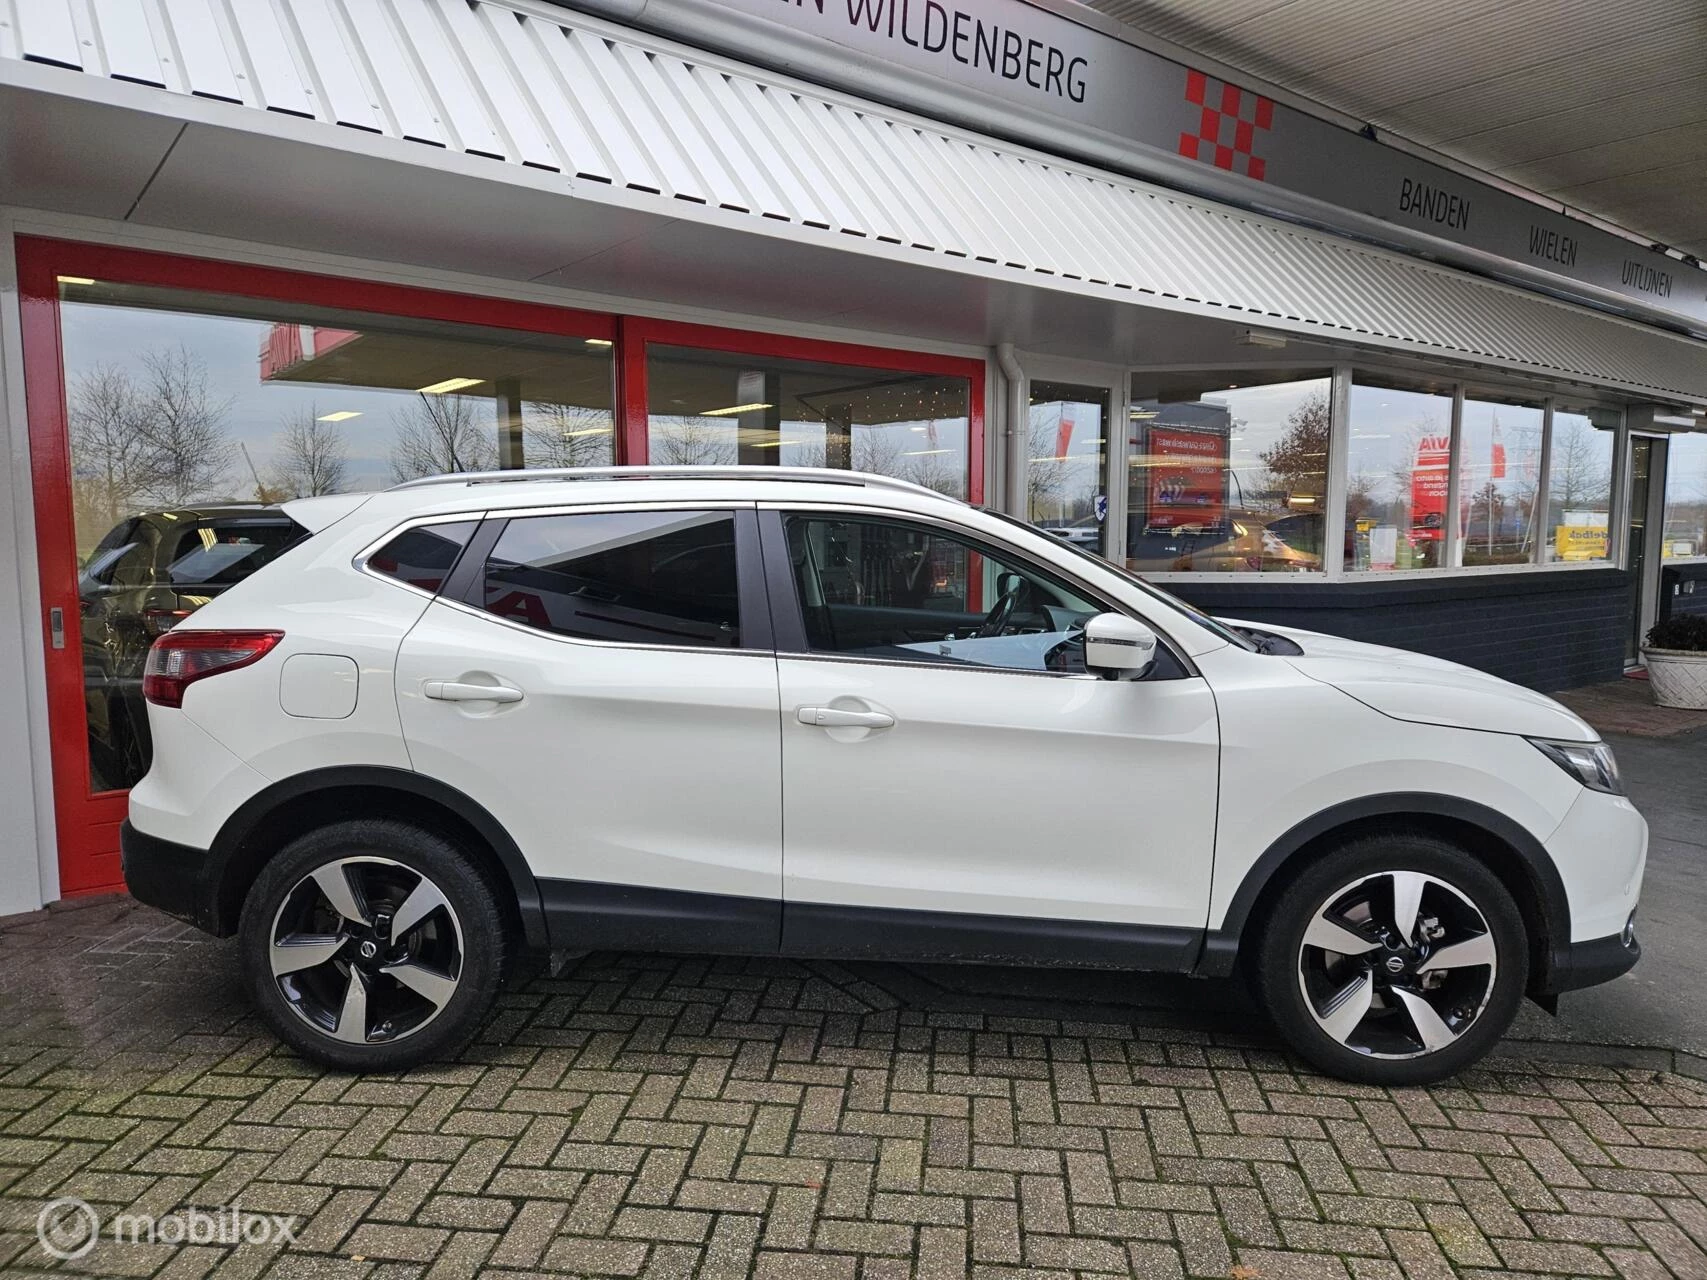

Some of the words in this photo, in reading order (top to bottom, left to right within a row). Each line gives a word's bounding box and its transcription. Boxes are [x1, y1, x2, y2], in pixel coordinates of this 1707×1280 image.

[847, 0, 1088, 103] WILDENBERG
[1399, 178, 1470, 231] BANDEN
[1529, 225, 1578, 268] WIELEN
[1622, 259, 1673, 298] UITLIJNEN
